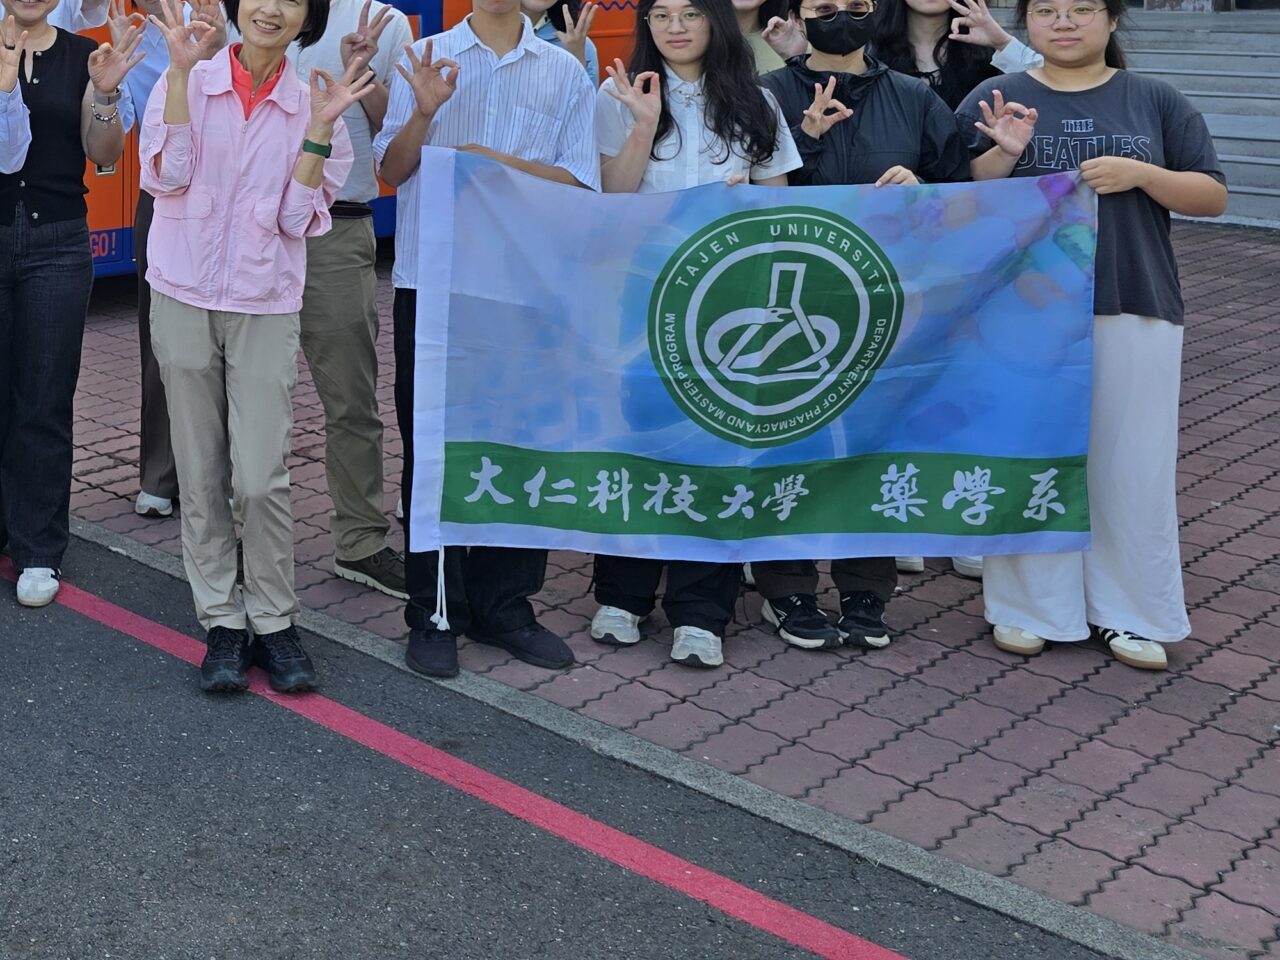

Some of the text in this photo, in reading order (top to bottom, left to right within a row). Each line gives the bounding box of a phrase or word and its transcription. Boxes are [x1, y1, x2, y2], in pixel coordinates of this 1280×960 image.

[1062, 119, 1094, 132] THE
[675, 223, 885, 295] TAJEN UNIVERSITY
[665, 313, 688, 380] PROGRAM
[838, 318, 886, 395] DEPARTMENT
[683, 379, 727, 420] MASTER
[822, 393, 837, 409] OF
[463, 456, 1067, 526] 大仁科技大學 藥學系
